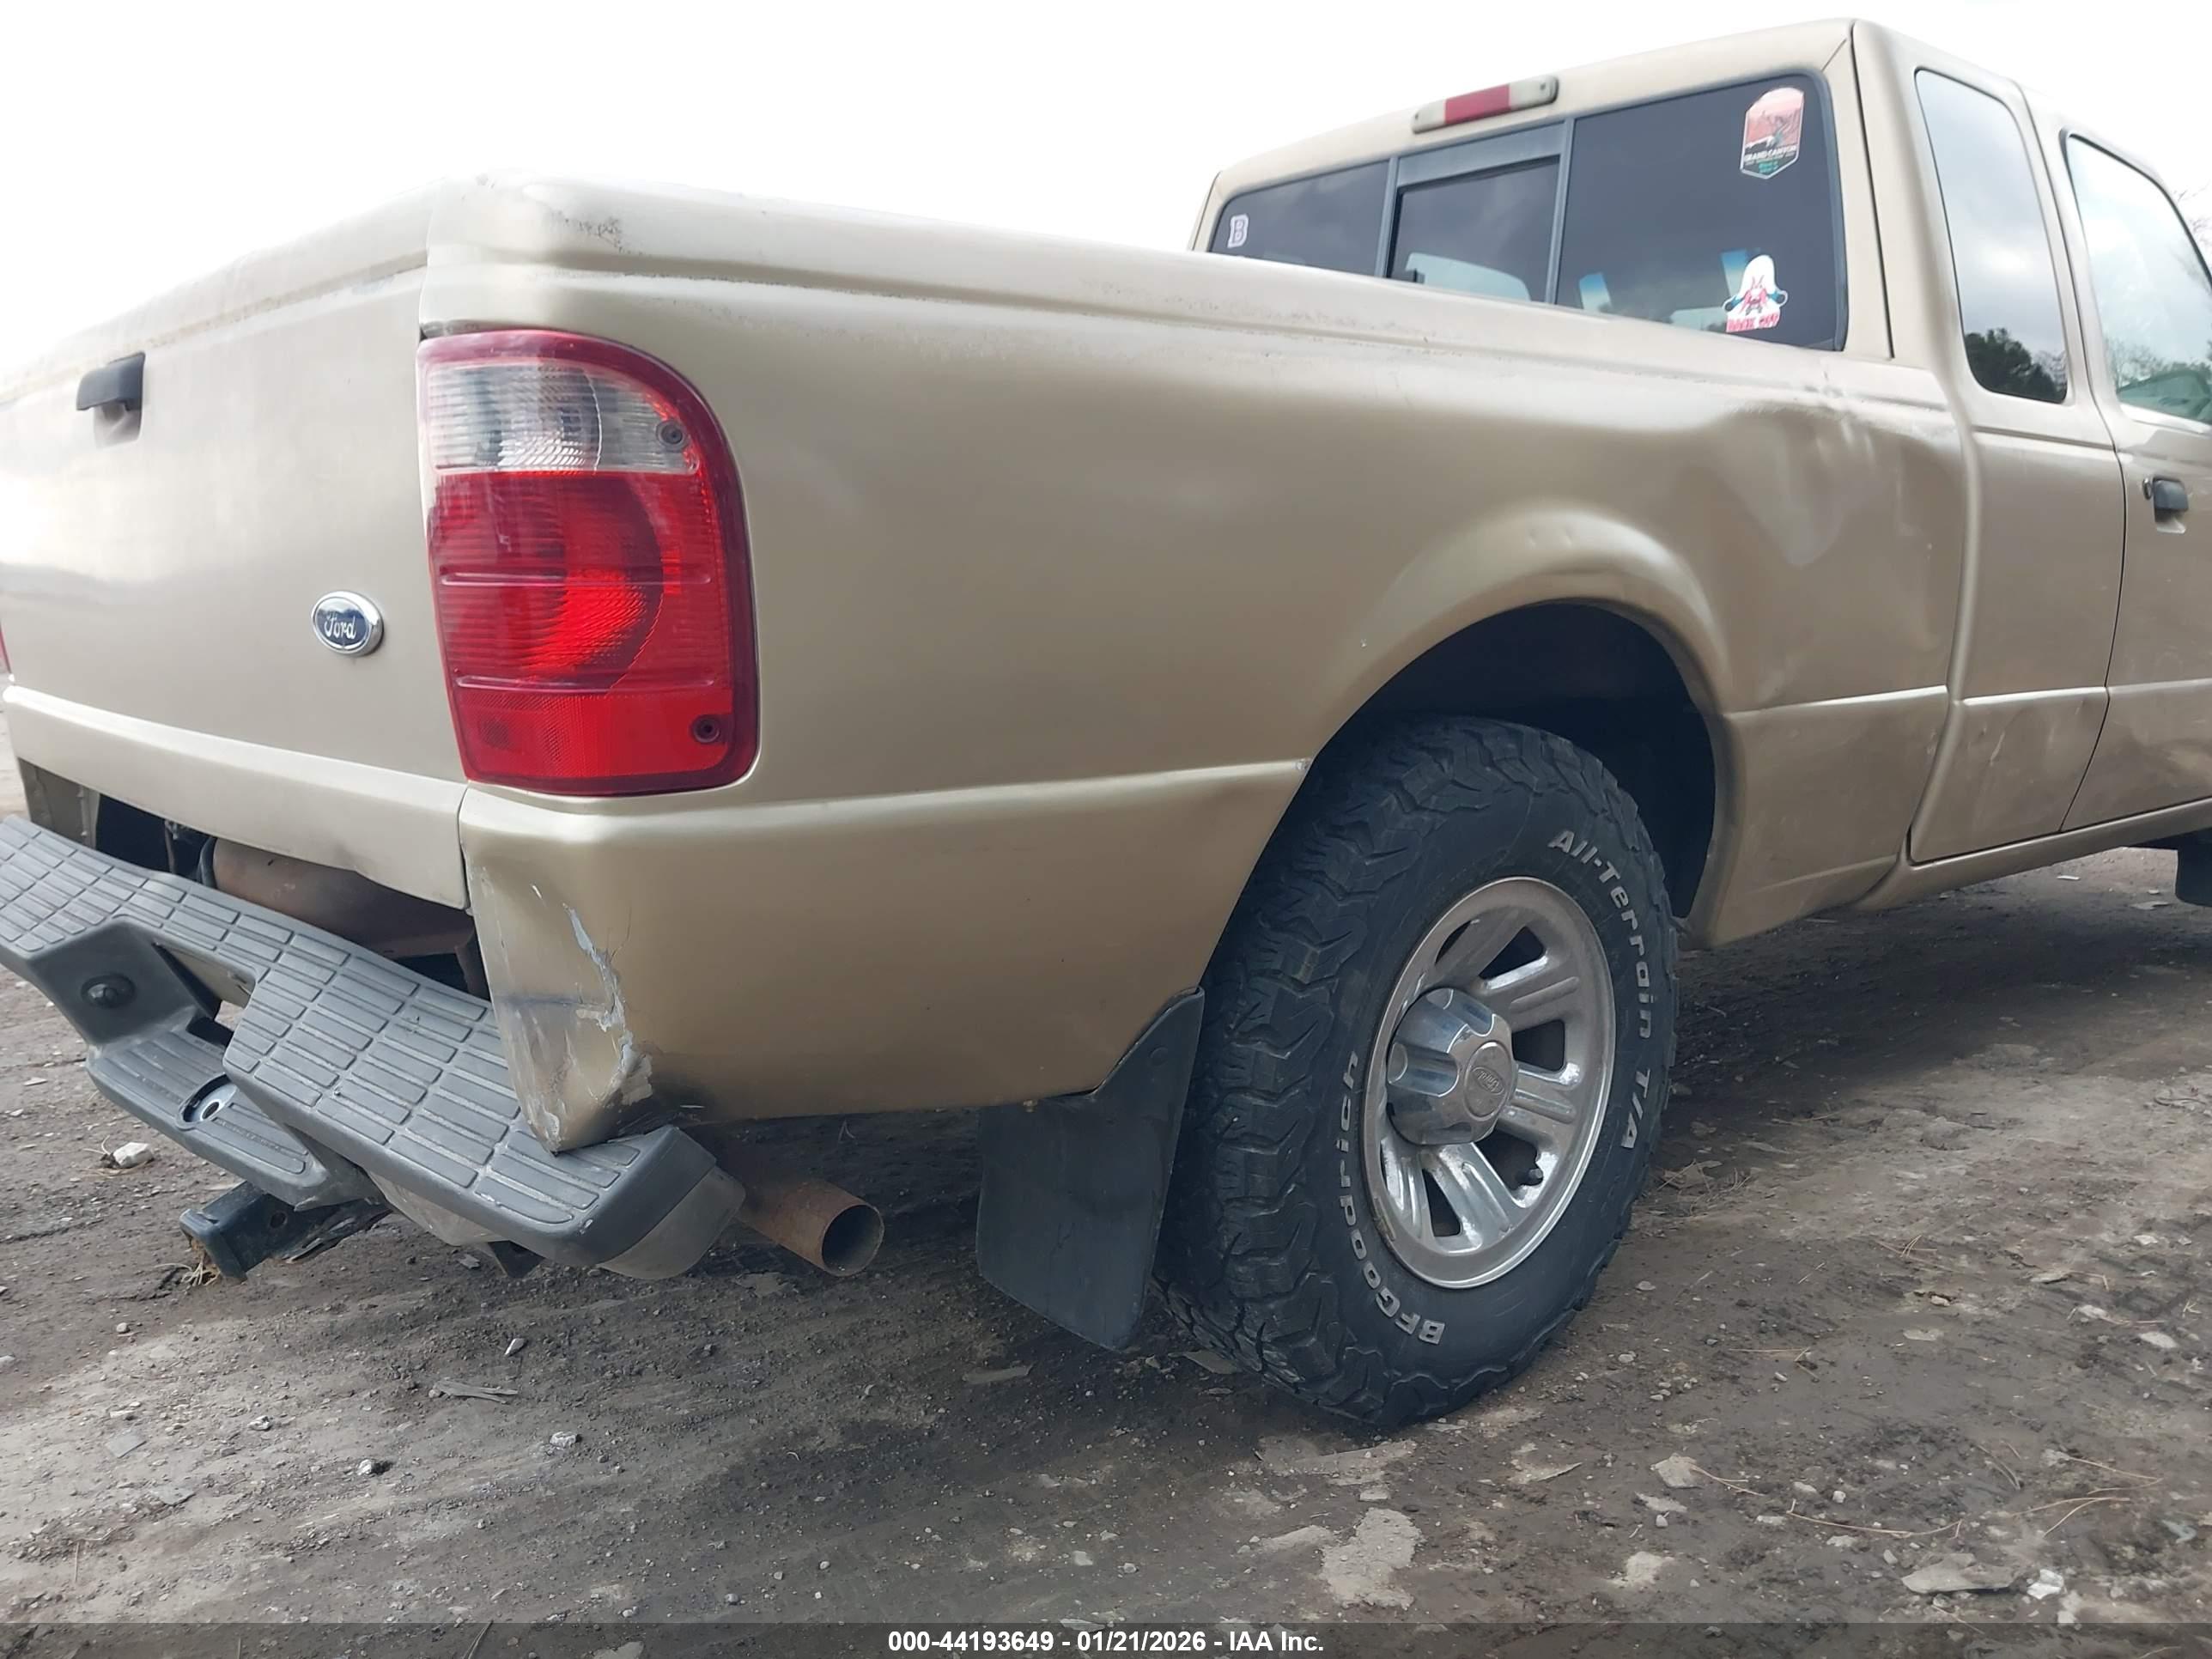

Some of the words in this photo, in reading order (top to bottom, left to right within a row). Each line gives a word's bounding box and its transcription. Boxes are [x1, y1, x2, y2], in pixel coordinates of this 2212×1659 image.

[1228, 214, 1249, 248] B
[324, 611, 356, 639] Ford
[1547, 830, 1656, 1038] All-Terrain
[1620, 1068, 1651, 1149] T/A
[1336, 1051, 1445, 1345] BFGoodrich
